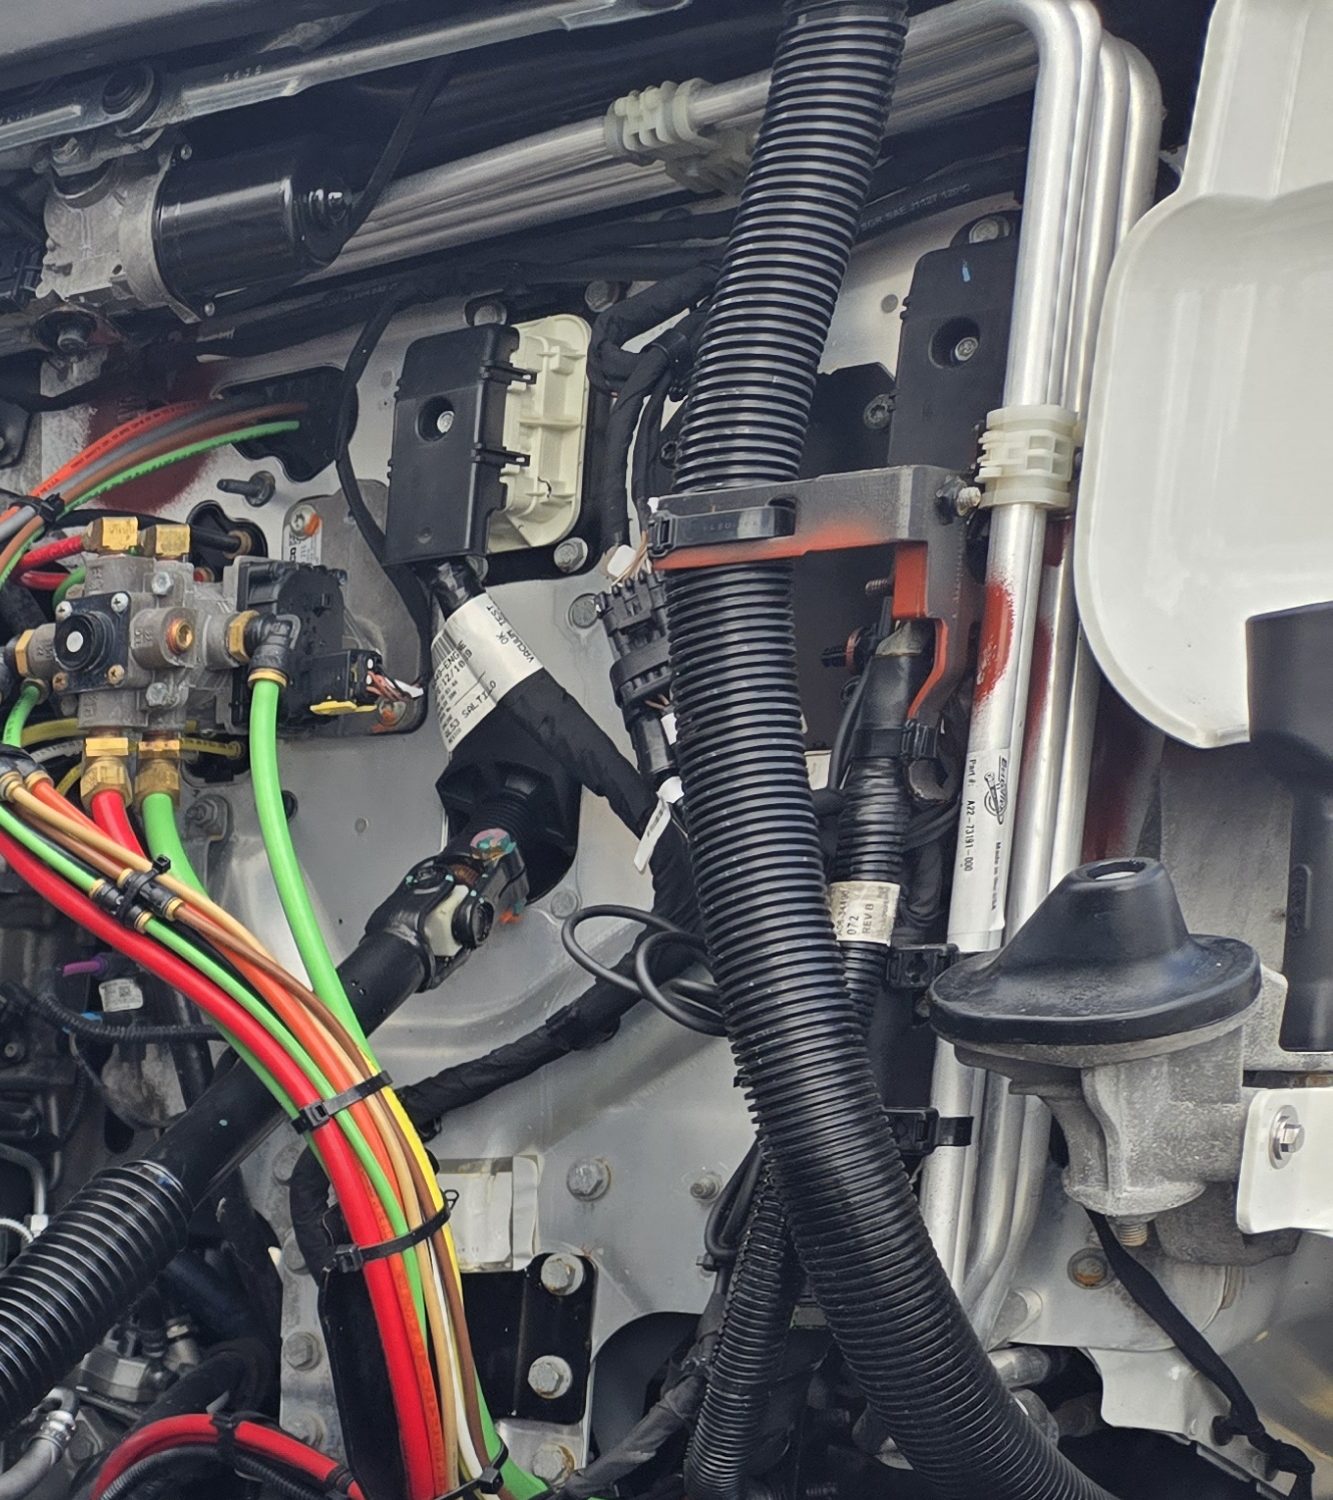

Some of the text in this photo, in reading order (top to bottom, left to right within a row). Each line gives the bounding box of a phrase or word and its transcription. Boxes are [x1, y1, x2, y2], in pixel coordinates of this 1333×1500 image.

[486, 605, 535, 663] VACUUM TEST
[496, 631, 509, 645] OK
[846, 915, 859, 935] 072
[862, 913, 873, 934] REV
